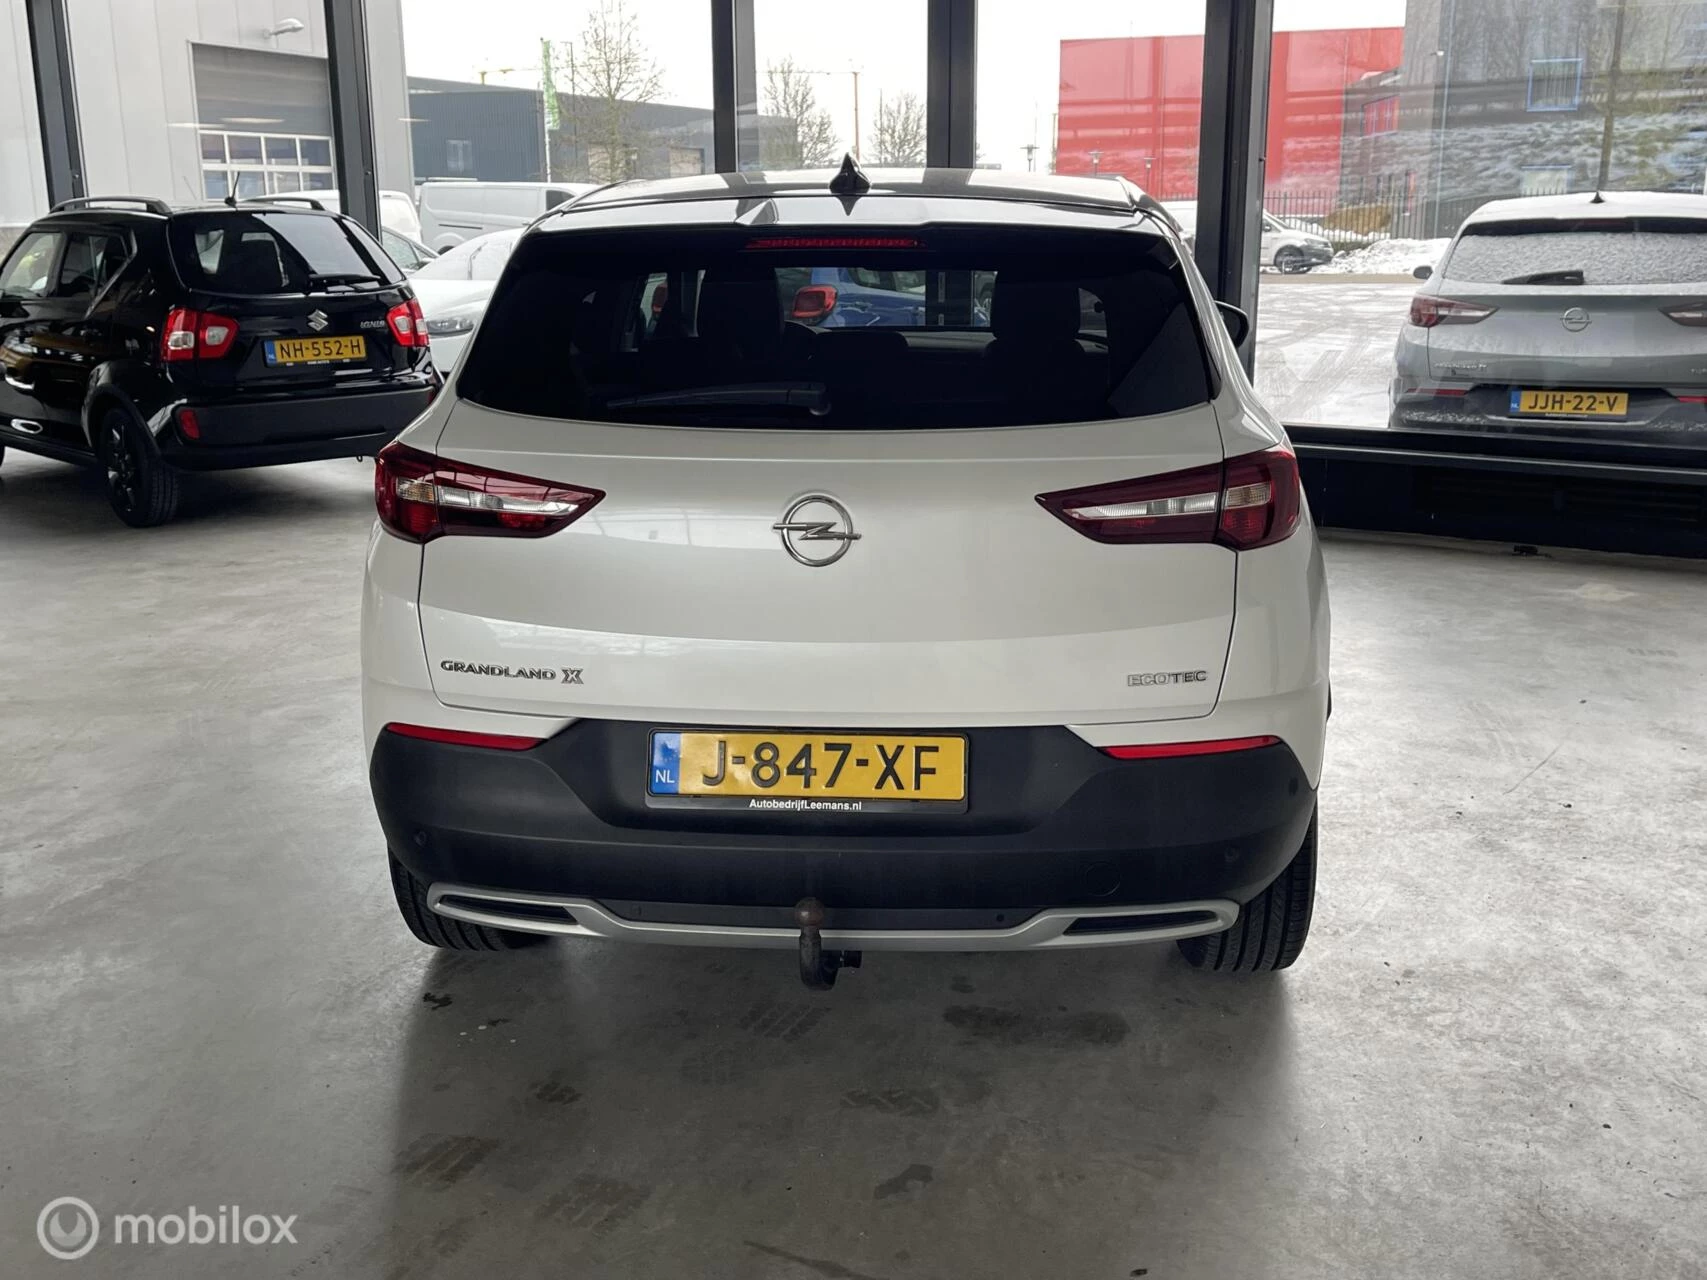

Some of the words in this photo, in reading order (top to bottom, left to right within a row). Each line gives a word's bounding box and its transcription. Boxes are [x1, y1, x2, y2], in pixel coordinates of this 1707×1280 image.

[280, 338, 361, 359] NH-552-H
[1528, 393, 1618, 412] JJH-22-V
[440, 660, 557, 681] GRANDLAND
[561, 667, 585, 685] X
[1127, 670, 1207, 687] ECOTEC
[655, 769, 675, 784] NL
[702, 740, 940, 791] J-847-XF
[749, 798, 862, 812] AutobedrijfLeemans.nl
